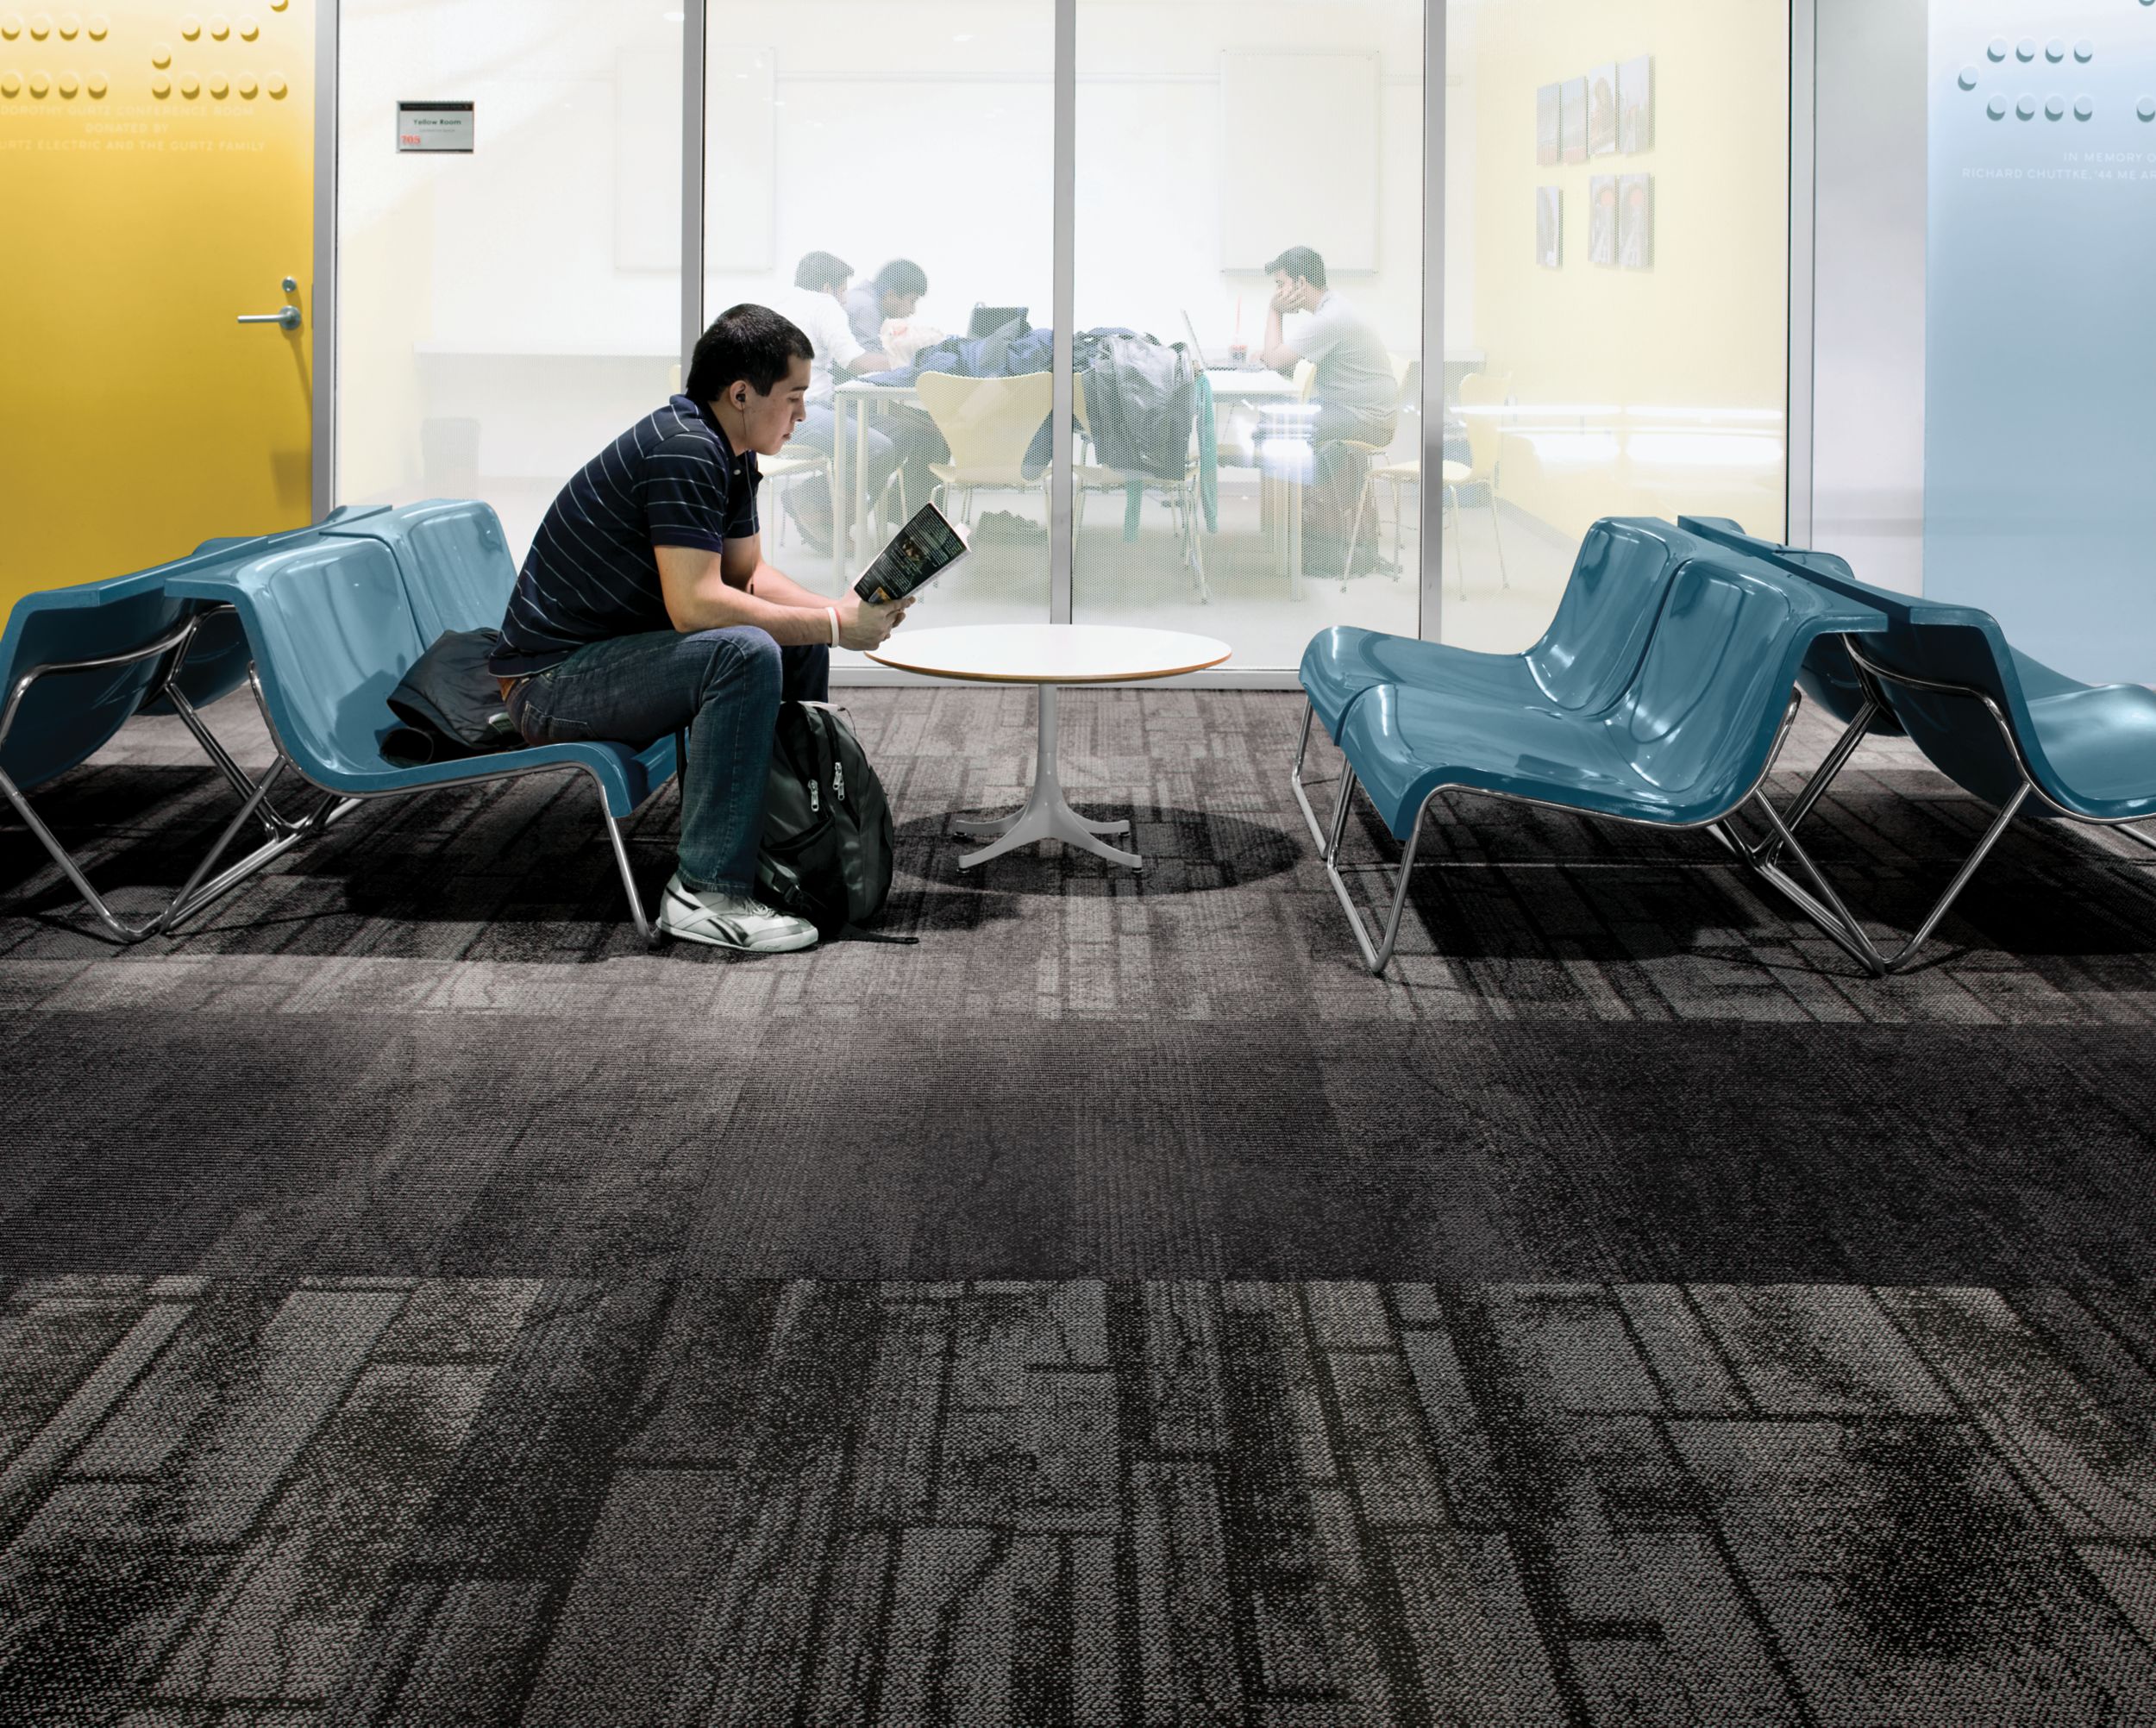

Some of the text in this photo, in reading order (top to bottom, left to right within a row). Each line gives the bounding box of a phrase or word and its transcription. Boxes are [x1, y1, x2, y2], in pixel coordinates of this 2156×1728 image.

[1, 105, 63, 116] DOROTHY
[214, 105, 254, 116] ROOM
[85, 123, 170, 134] DONATED BY
[0, 140, 266, 151] URTZ ELECTRIC AND THE GURTZ FAMILY
[2063, 152, 2156, 163] IN MEMORY O
[1962, 167, 2021, 178] RICHARD
[2117, 170, 2136, 180] ME
